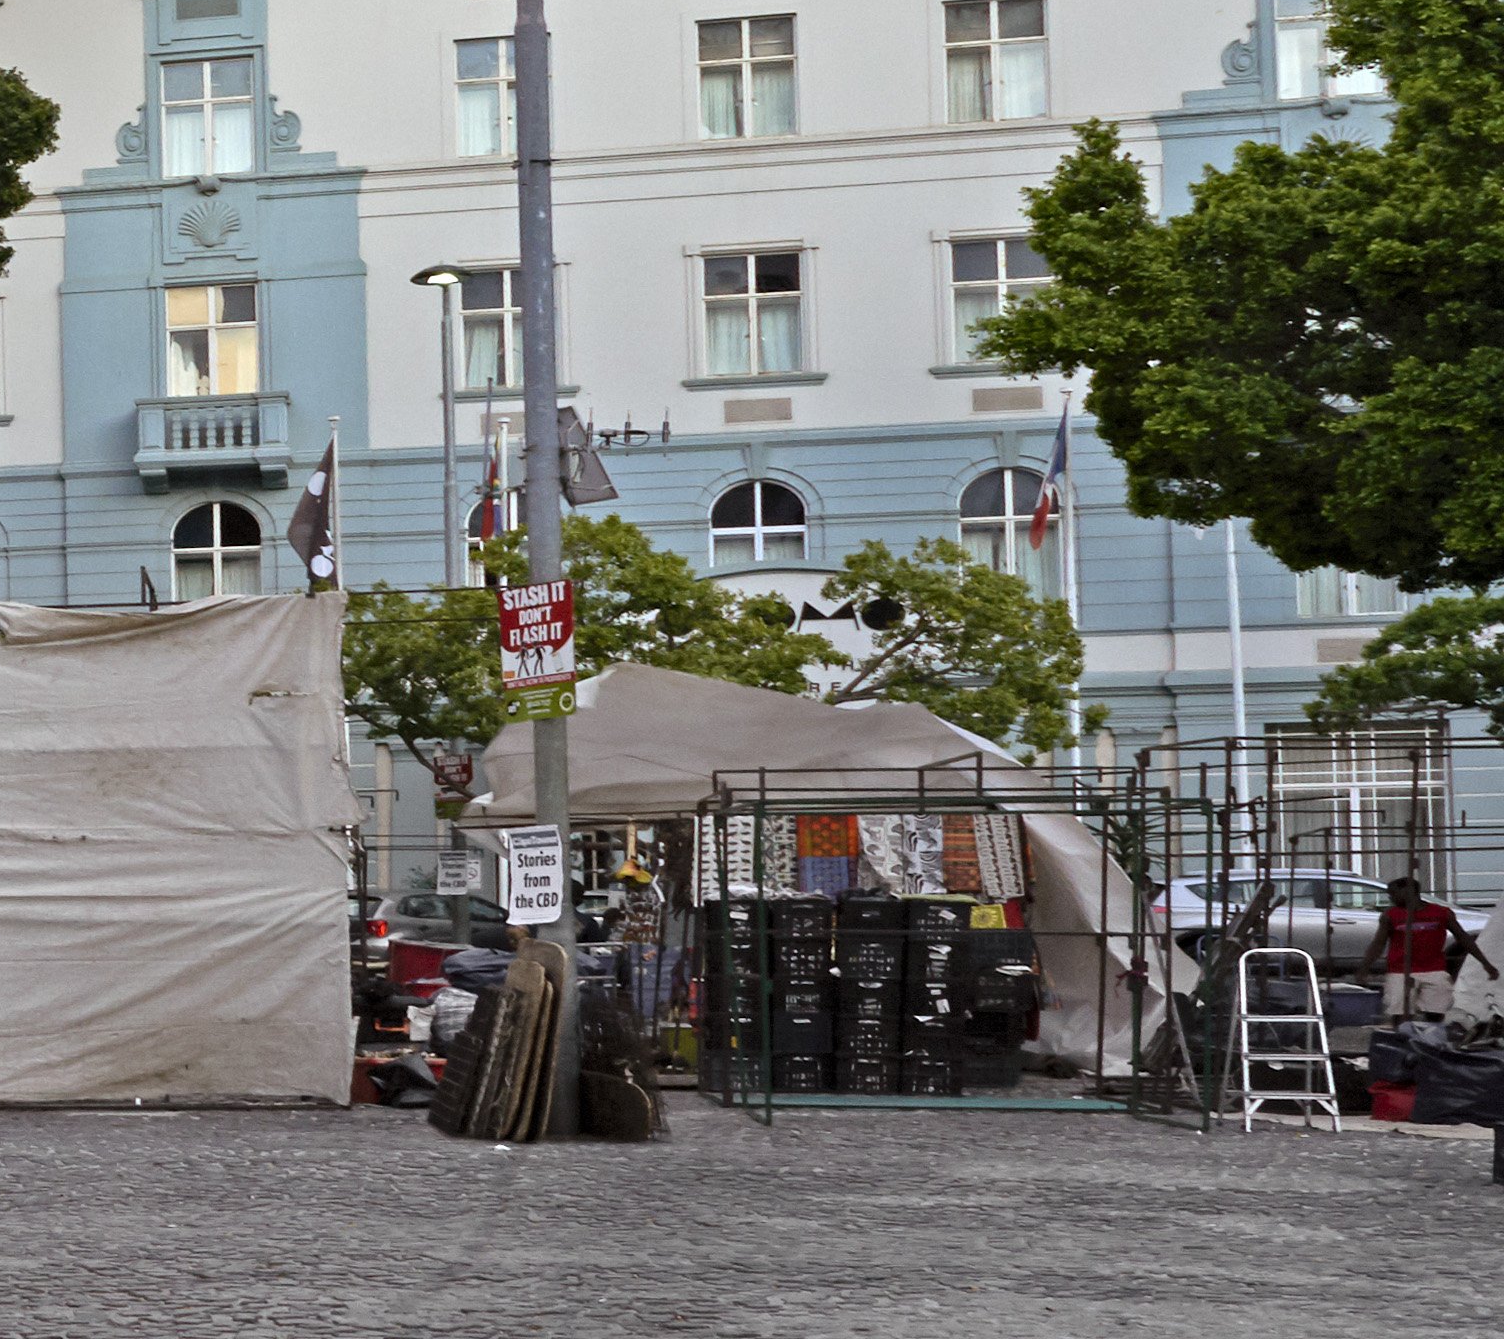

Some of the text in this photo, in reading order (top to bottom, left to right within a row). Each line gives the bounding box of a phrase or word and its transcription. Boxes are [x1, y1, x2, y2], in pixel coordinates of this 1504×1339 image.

[502, 581, 566, 611] STASH IT
[518, 605, 553, 626] DON'T
[509, 621, 563, 647] FLASH IT
[517, 850, 557, 869] Stories
[523, 872, 551, 888] from
[515, 892, 559, 909] the CBD
